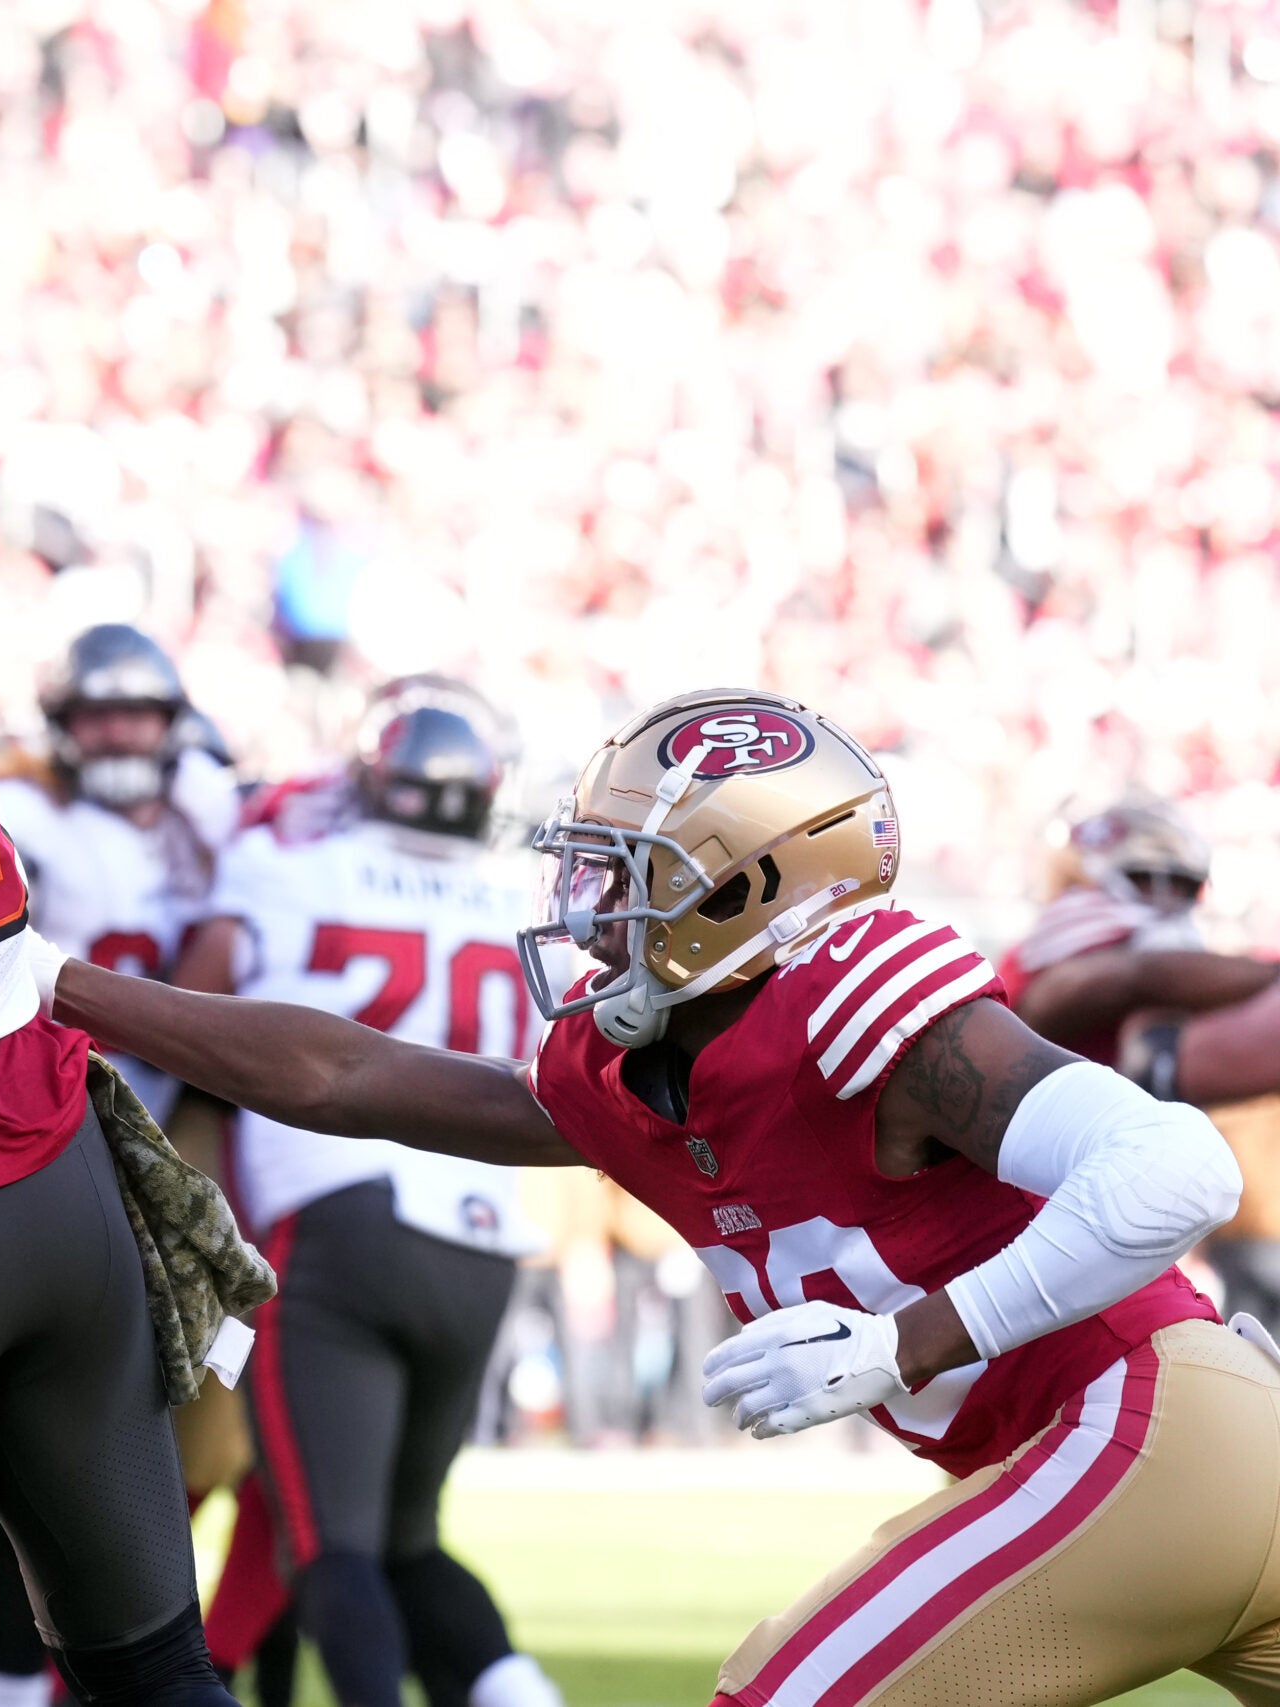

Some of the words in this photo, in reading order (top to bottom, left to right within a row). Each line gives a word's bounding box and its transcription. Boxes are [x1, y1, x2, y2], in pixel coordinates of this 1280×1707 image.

[700, 714, 791, 769] SF
[881, 858, 893, 876] 64
[830, 883, 847, 897] 20
[302, 922, 531, 1059] 70
[712, 1204, 762, 1236] 49ERS
